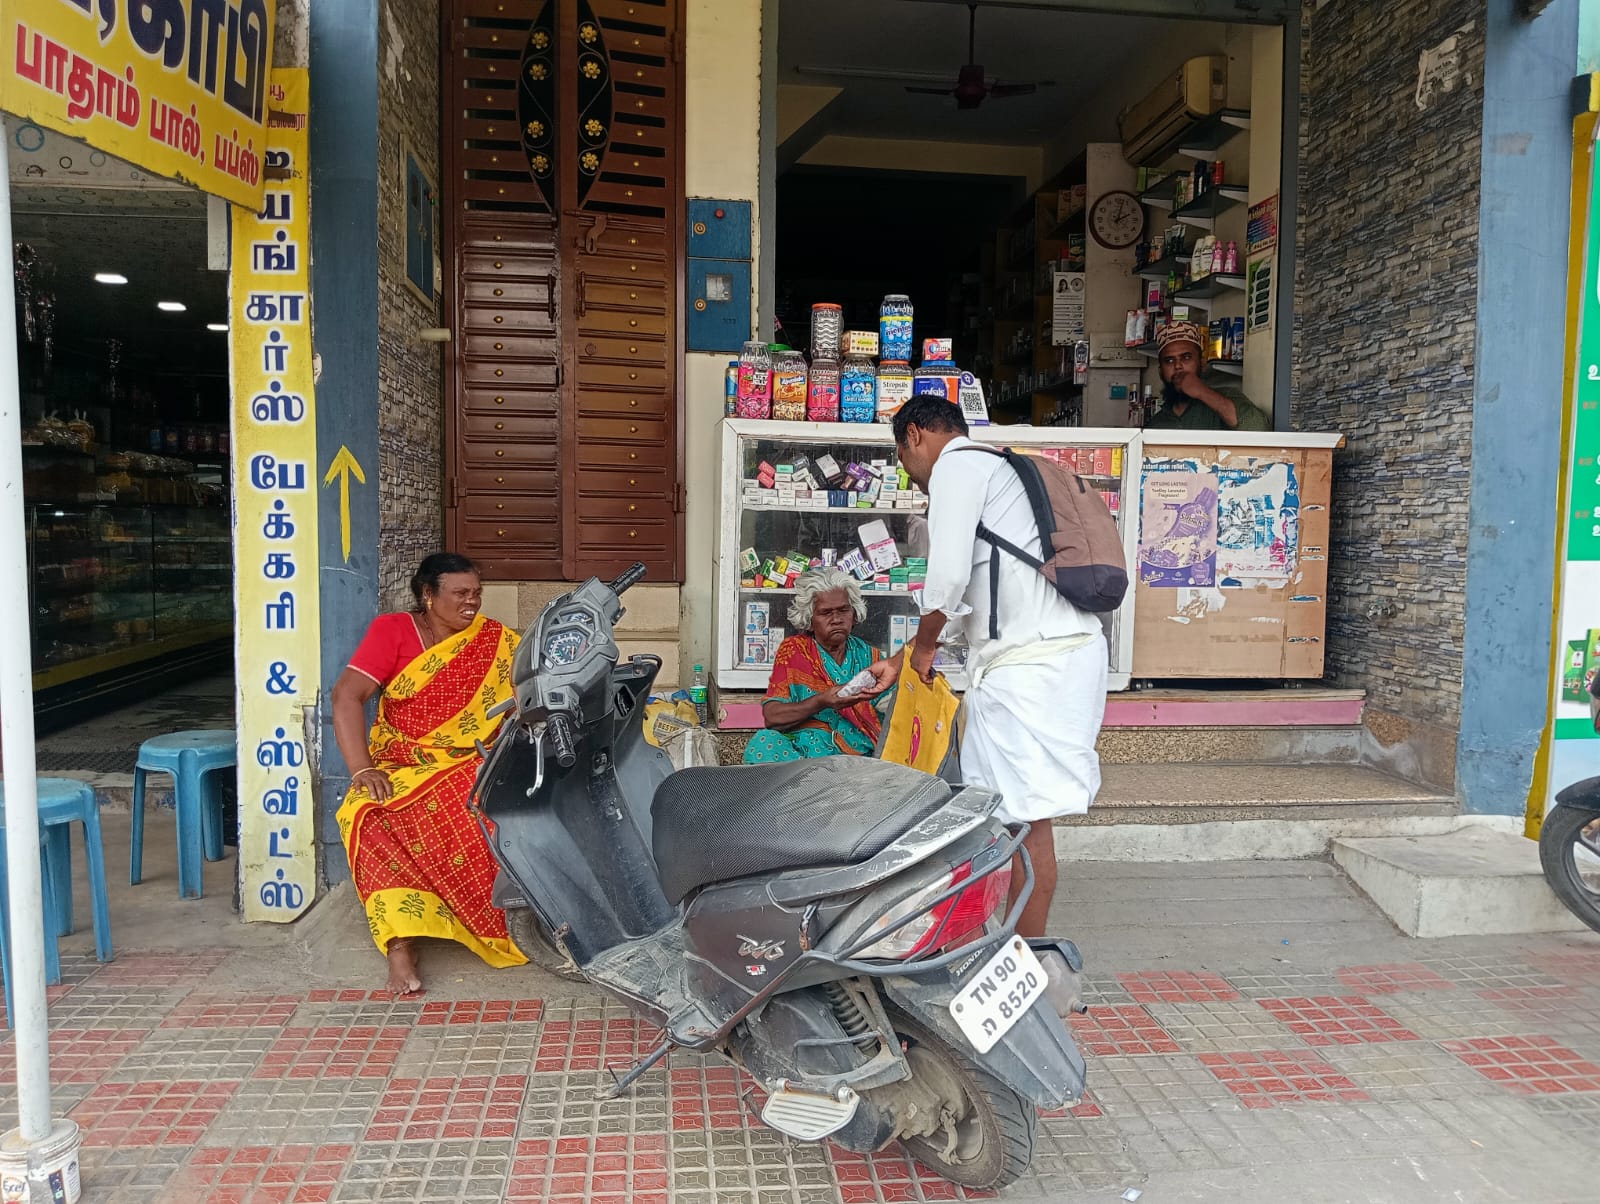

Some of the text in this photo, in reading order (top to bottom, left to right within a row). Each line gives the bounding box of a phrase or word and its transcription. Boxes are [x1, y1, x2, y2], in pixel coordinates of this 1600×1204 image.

[15, 23, 141, 128] பாதாம்
[214, 128, 260, 187] பப்ஸ்
[250, 455, 305, 629] பேக்கரி
[265, 661, 297, 694] &
[256, 727, 304, 909] ஸ்வீட்ஸ்
[970, 956, 1017, 1006] TN 90
[998, 971, 1038, 1019] 8520
